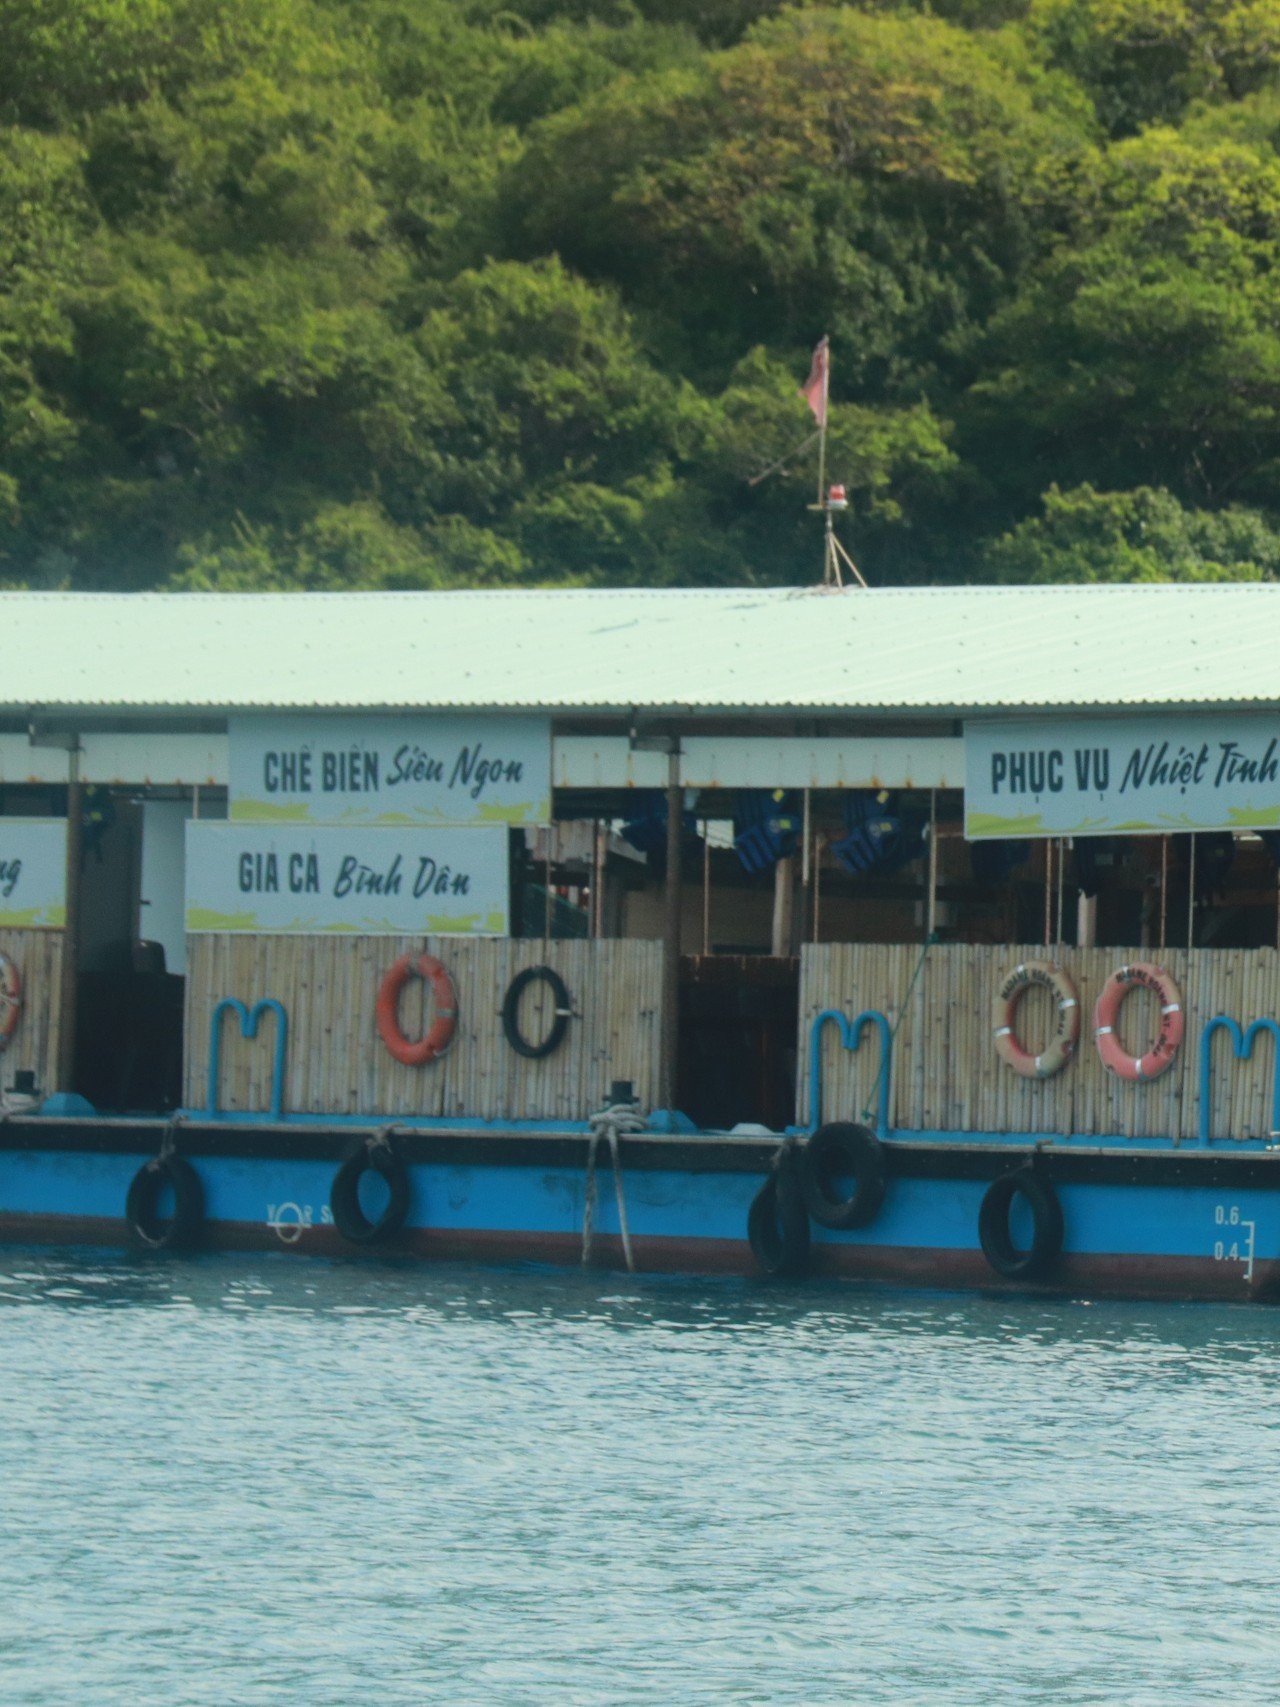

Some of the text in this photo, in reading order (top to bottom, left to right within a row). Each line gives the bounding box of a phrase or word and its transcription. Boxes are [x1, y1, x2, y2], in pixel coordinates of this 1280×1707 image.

[447, 742, 523, 799] Ngon
[991, 738, 1279, 803] PHỤC VỤ Nhiệt Tình
[333, 853, 402, 899] Bình
[412, 856, 471, 899] Dân
[1214, 1204, 1240, 1226] 0.6
[1213, 1241, 1239, 1262] 0.4
